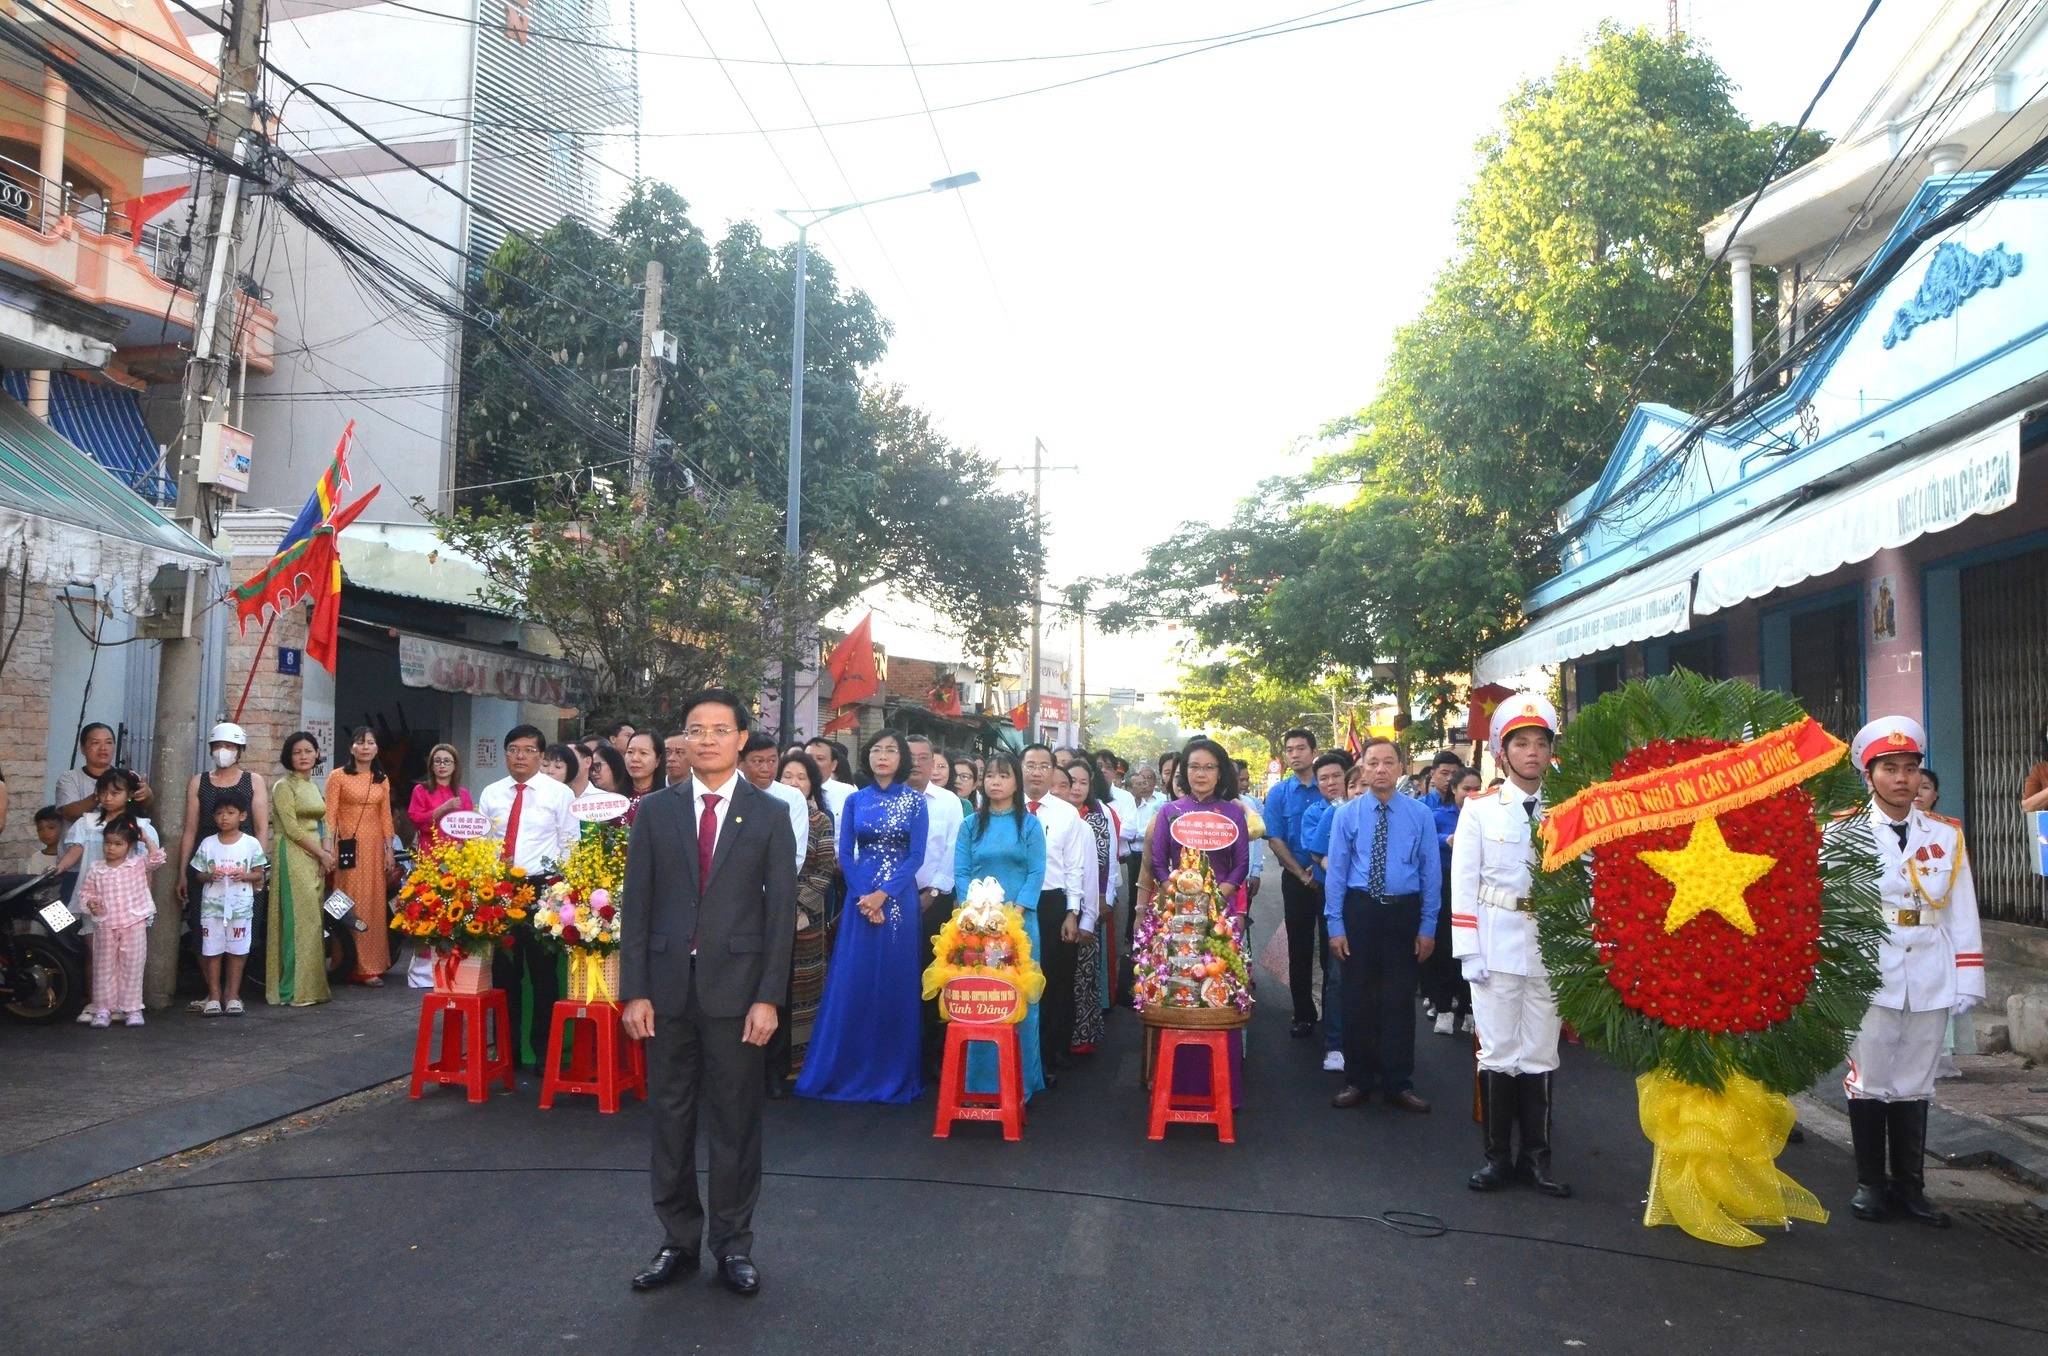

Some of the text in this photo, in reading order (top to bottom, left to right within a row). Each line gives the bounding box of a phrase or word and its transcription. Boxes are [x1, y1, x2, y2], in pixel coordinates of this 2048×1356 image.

[287, 652, 294, 665] 8
[1641, 780, 1675, 812] NHỚ
[1674, 777, 1699, 805] ƠN
[1698, 766, 1731, 799] CÁC
[1727, 758, 1762, 788] VUA
[1758, 742, 1801, 776] HÙNG
[949, 1001, 1009, 1017] Kính Dâng
